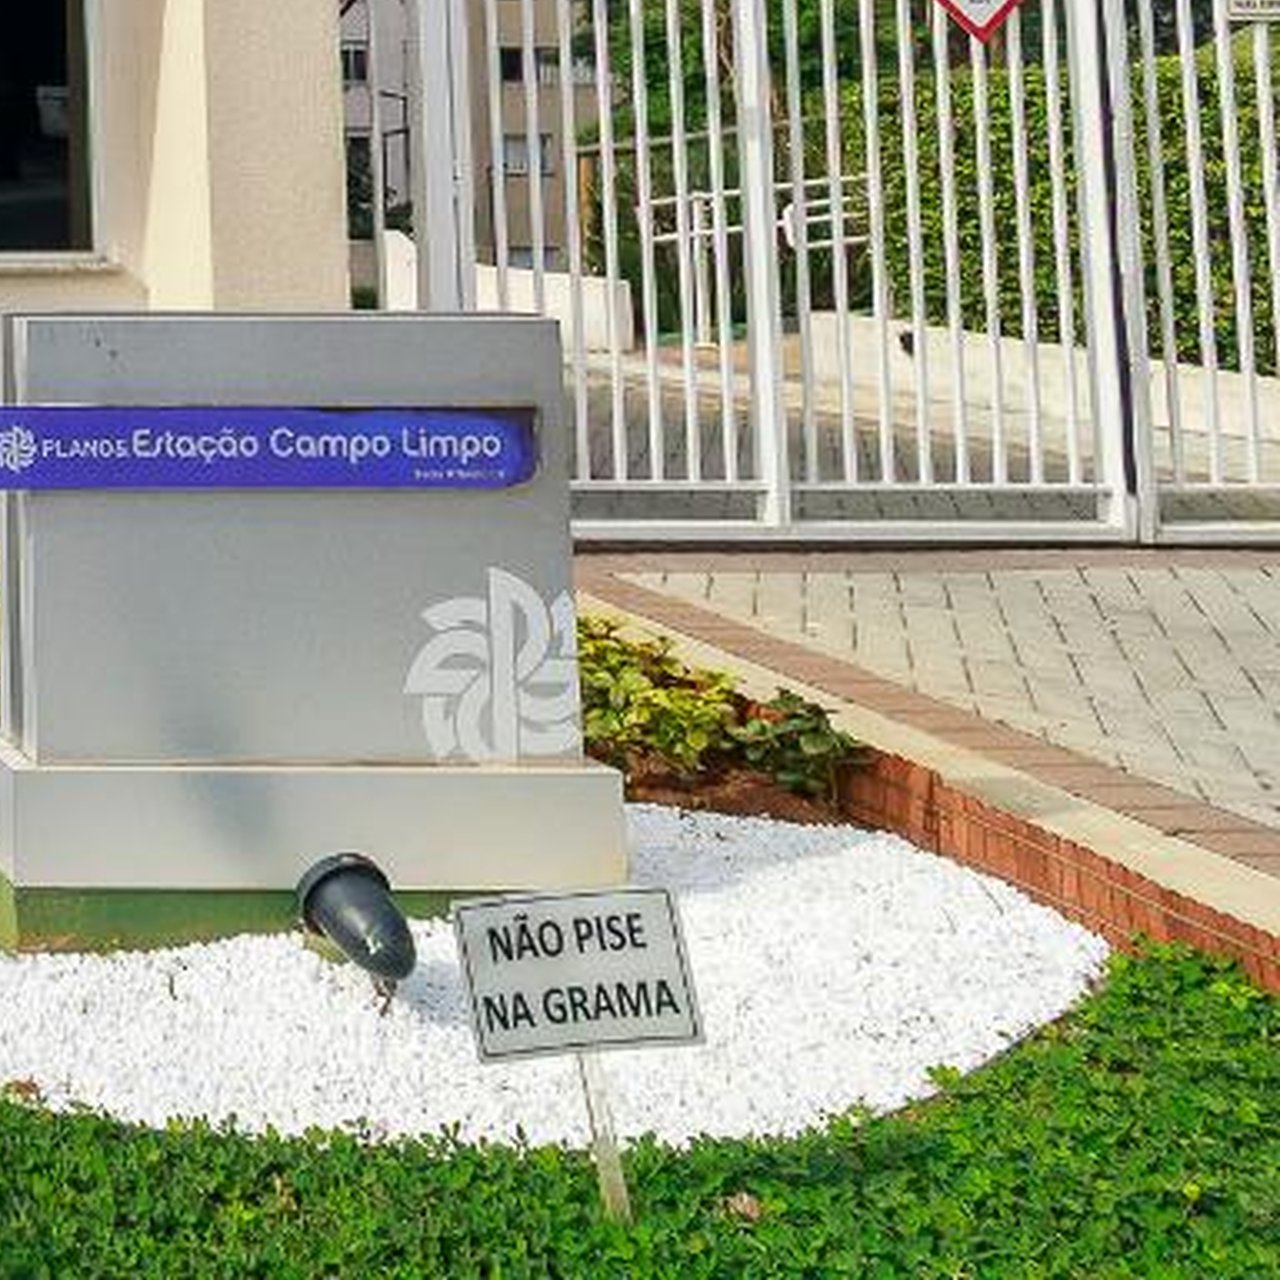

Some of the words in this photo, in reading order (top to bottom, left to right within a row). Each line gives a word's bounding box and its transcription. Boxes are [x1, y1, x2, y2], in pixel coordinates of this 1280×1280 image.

[132, 427, 260, 464] Estação
[269, 426, 391, 464] Campo
[401, 427, 502, 465] Limpo
[486, 912, 565, 964] NÃO
[571, 912, 648, 954] PISE
[481, 989, 537, 1033] NA
[541, 978, 681, 1026] GRAMA
